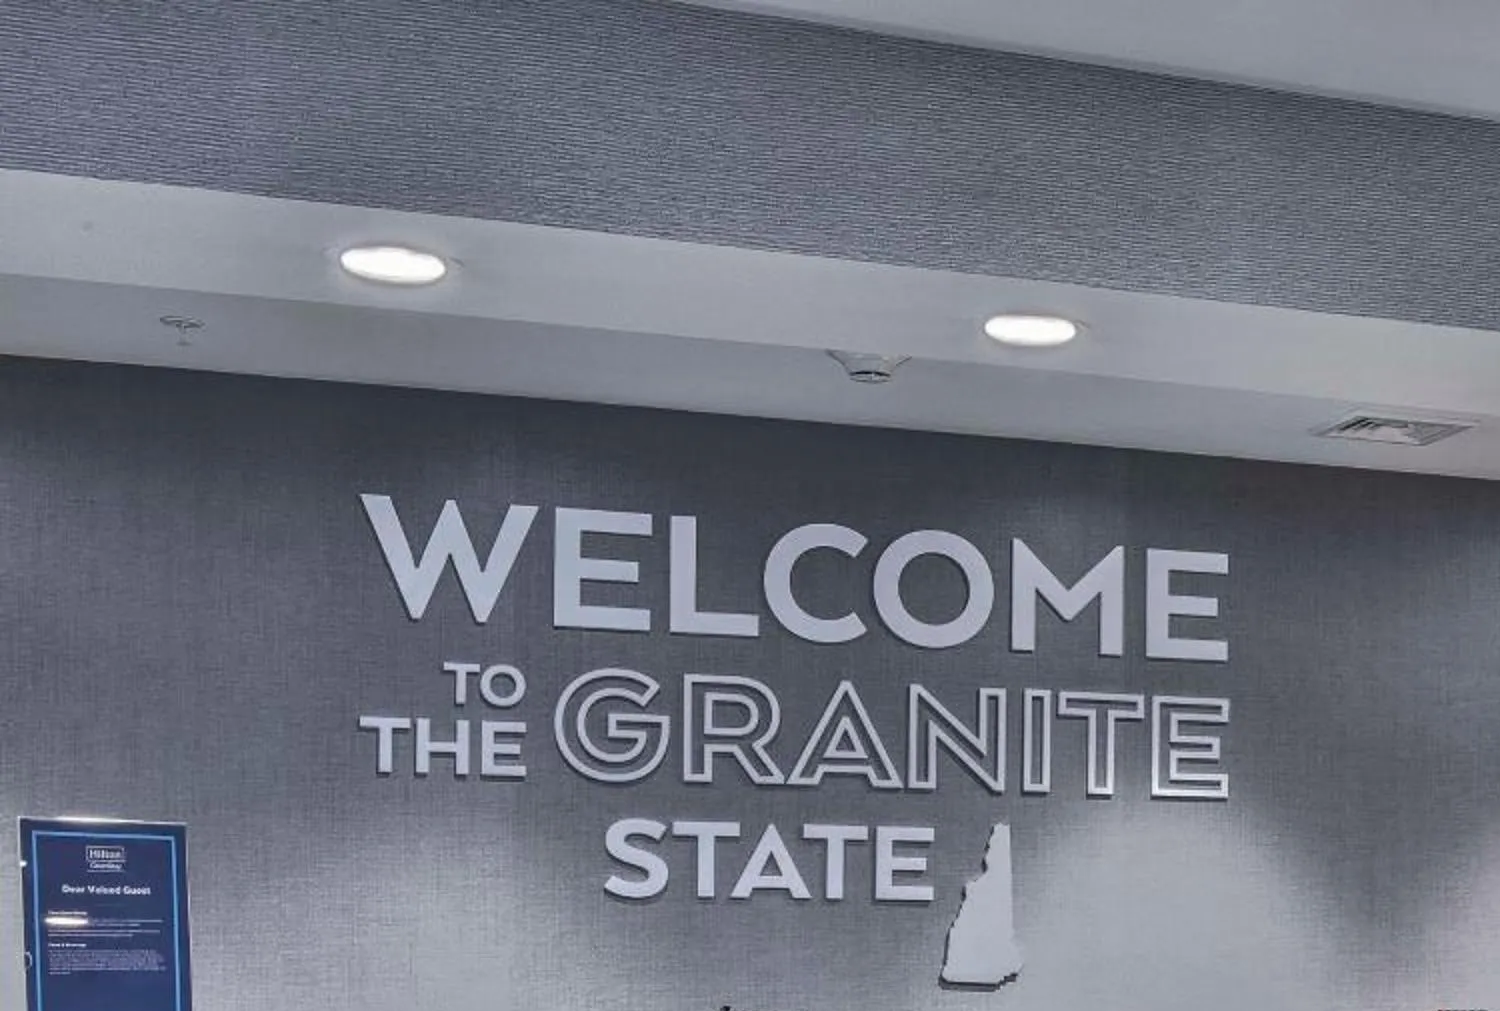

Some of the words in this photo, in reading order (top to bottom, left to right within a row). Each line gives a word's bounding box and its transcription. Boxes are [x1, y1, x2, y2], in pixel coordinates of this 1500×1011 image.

[359, 492, 1231, 663] WELCOME
[443, 661, 527, 707] TO
[359, 715, 527, 778] THE
[553, 667, 1232, 800] GRANITE
[61, 884, 85, 894] Dear
[123, 885, 151, 895] Guest
[603, 817, 936, 902] STATE
